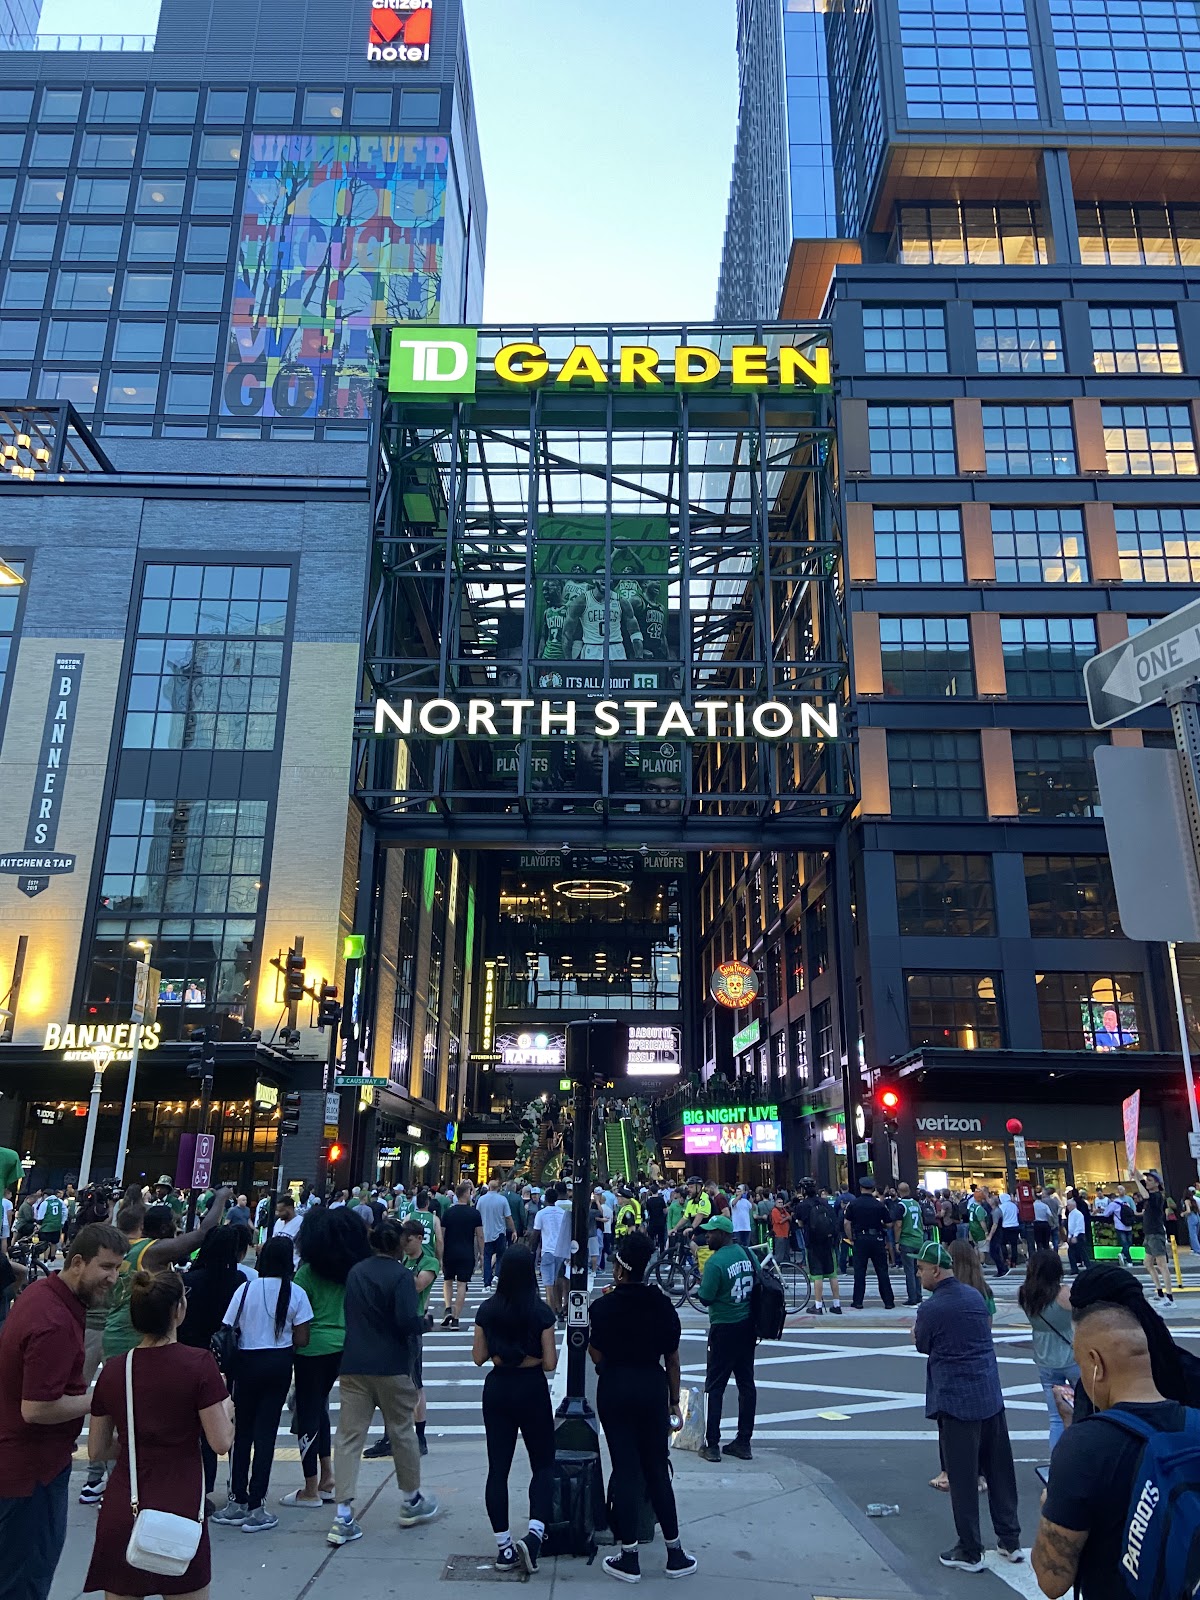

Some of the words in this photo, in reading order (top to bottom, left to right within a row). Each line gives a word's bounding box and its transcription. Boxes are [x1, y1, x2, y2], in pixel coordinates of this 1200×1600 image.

[367, 43, 430, 61] hotel
[400, 340, 468, 382] TD
[494, 342, 831, 387] GARDEN
[551, 628, 559, 642] 7
[1136, 638, 1183, 682] ONE
[584, 677, 600, 689] ALL
[373, 698, 576, 737] NORTH
[594, 699, 839, 739] STATION
[34, 676, 72, 844] BANNERS
[0, 858, 42, 868] KITCHEN
[44, 859, 52, 868] &
[53, 859, 73, 868] TAP
[520, 855, 561, 868] PLAYOFFS
[643, 856, 684, 868] PLAYOFFS
[483, 969, 494, 1050] BANNERS
[683, 1109, 704, 1125] BIG
[706, 1107, 747, 1124] NIGHT
[748, 1105, 779, 1122] LIVE
[916, 1115, 982, 1132] verizon
[911, 1213, 919, 1229] 7
[727, 1260, 753, 1280] HORFOR
[1122, 1479, 1160, 1580] PATRIOTS
